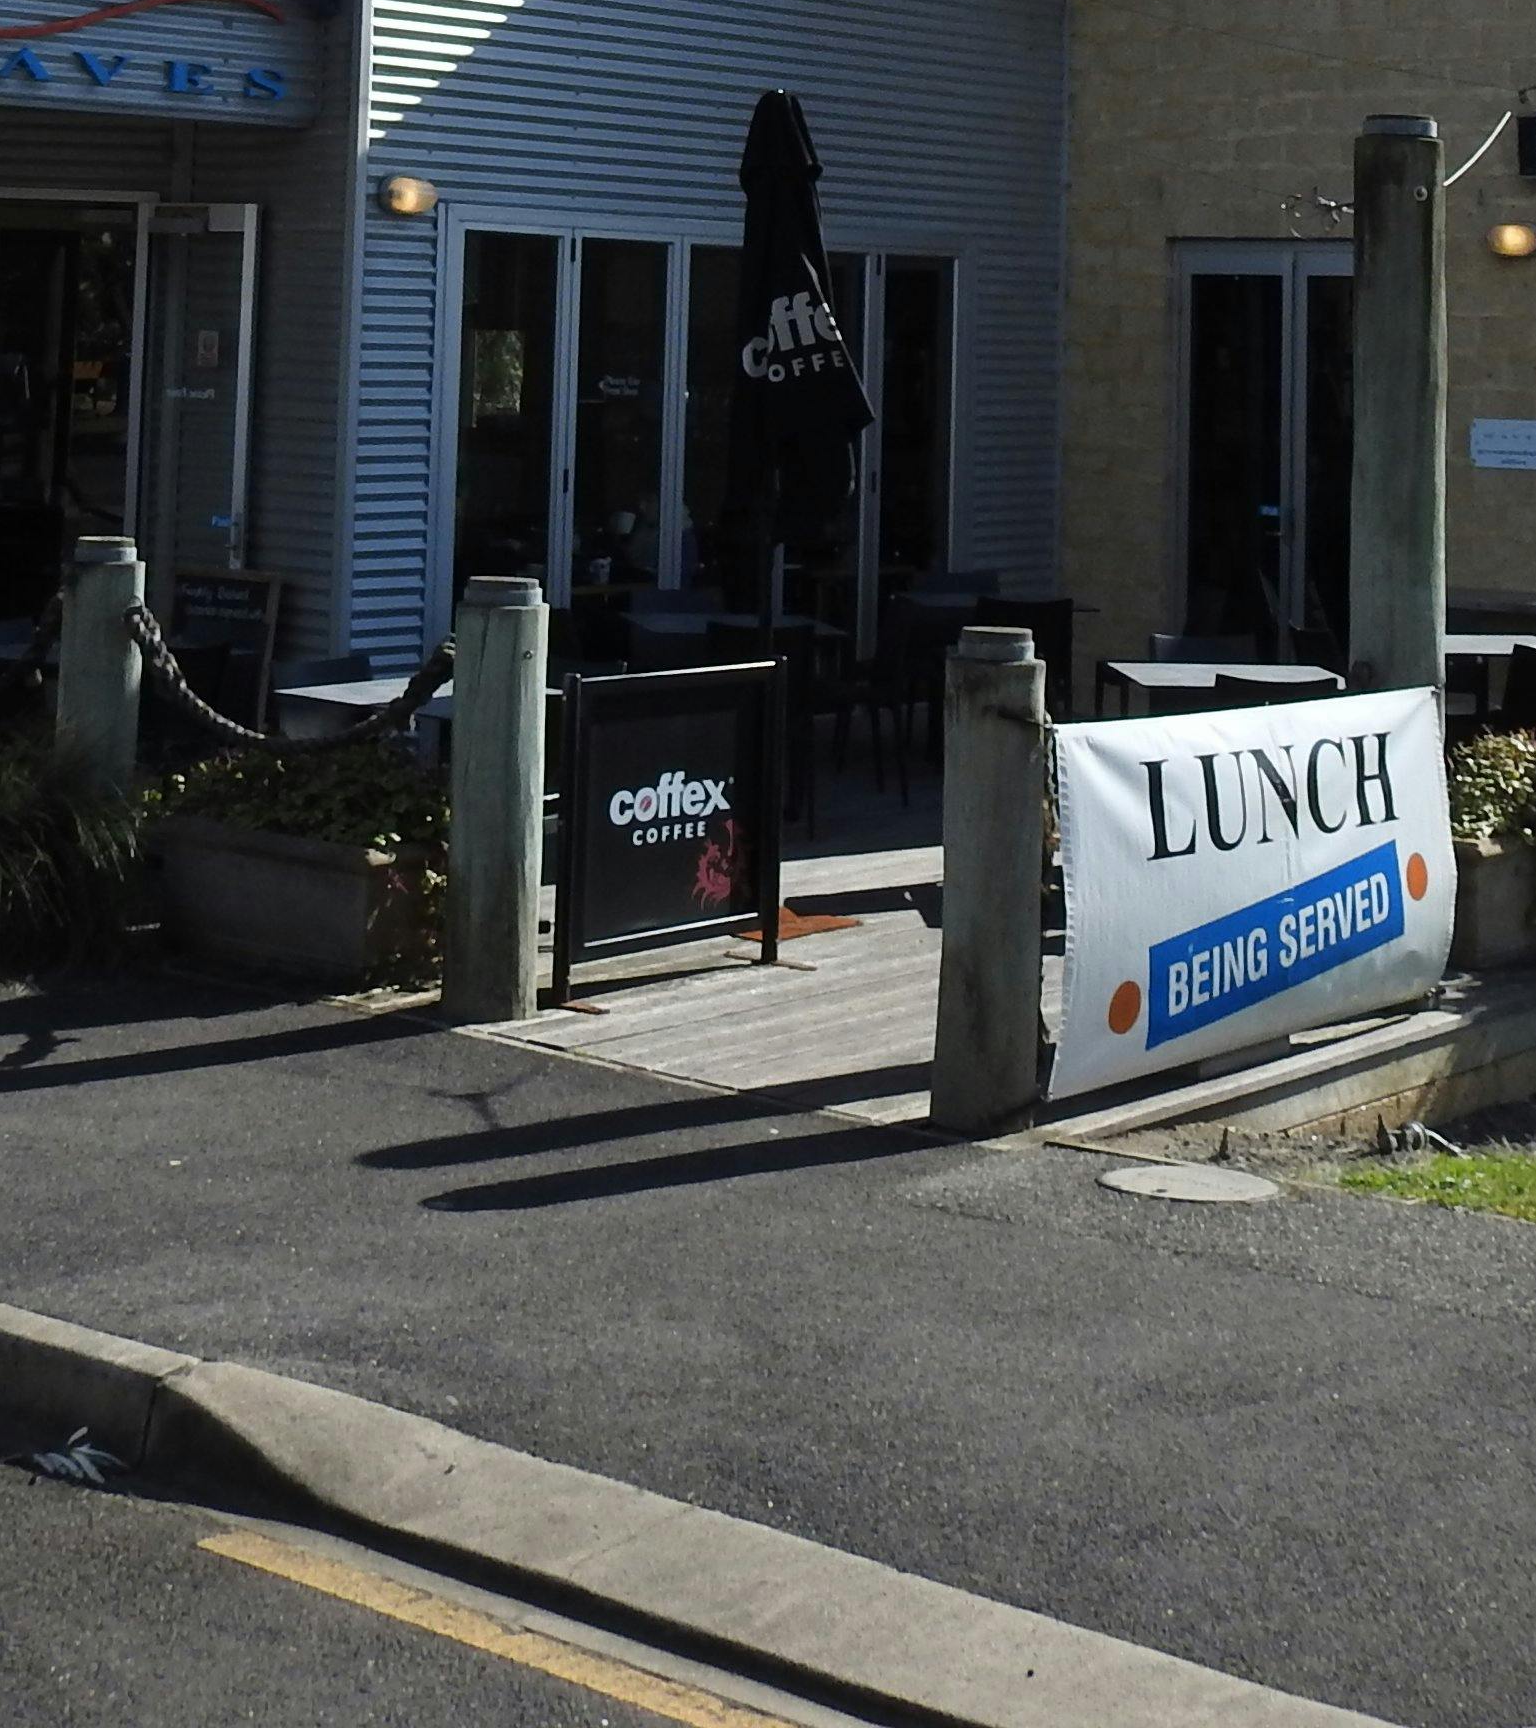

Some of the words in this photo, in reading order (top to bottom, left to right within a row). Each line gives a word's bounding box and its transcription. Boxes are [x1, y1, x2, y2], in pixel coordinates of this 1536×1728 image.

[609, 771, 730, 825] coffex
[632, 821, 707, 846] COFFEE
[1139, 732, 1399, 861] LUNCH
[1168, 928, 1268, 1017] BEING
[1279, 872, 1389, 968] SERVED
